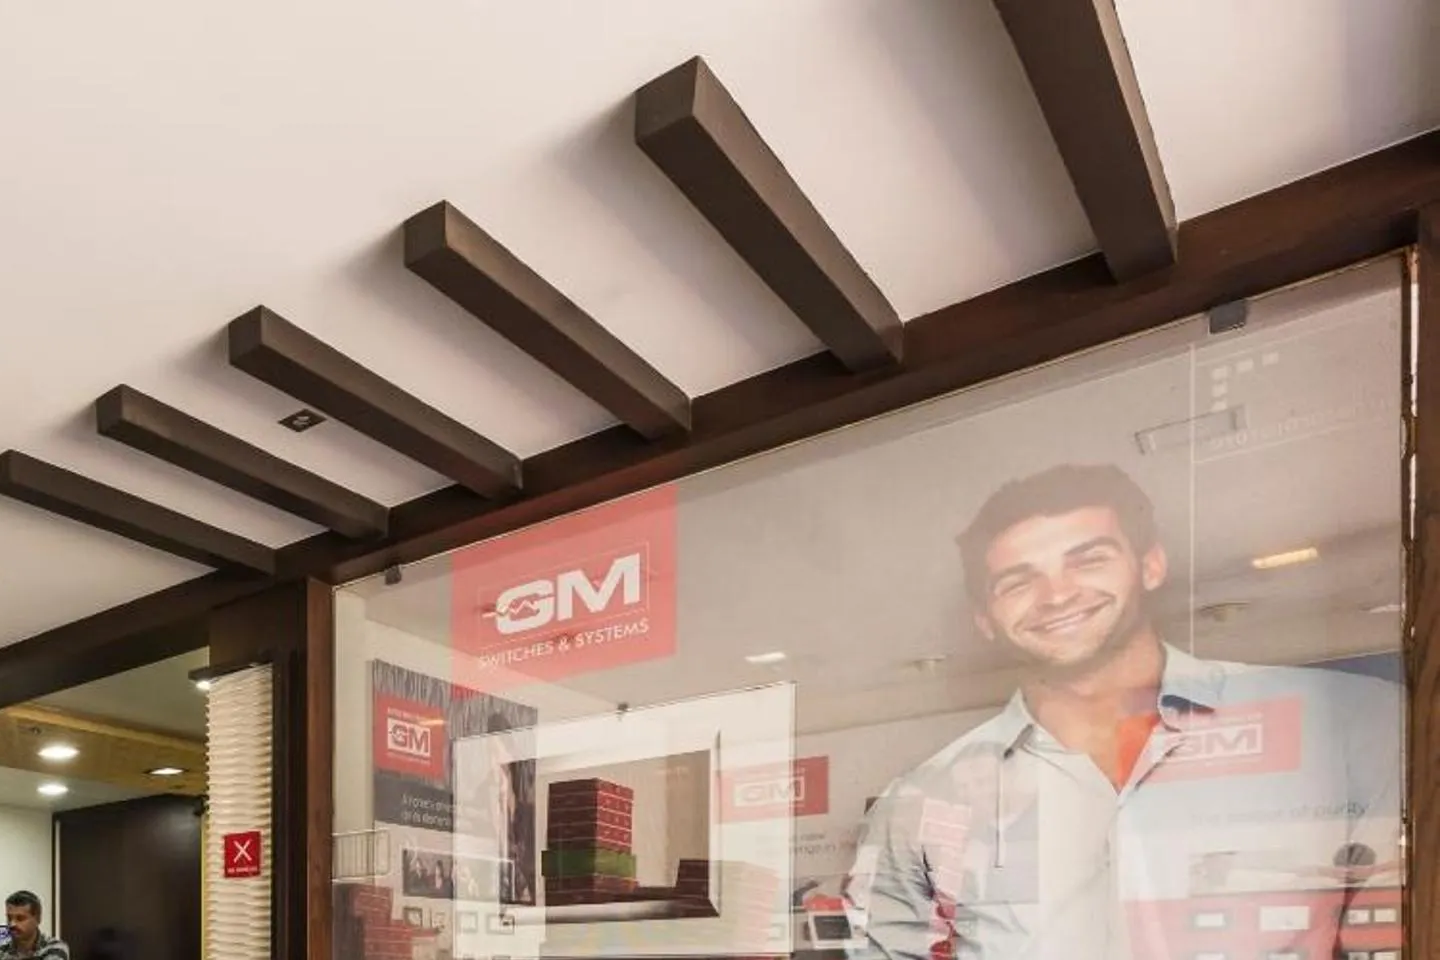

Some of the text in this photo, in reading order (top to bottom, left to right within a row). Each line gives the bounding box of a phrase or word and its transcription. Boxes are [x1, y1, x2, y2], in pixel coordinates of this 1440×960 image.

[484, 552, 641, 635] GM
[478, 618, 651, 670] SWITCHES & SYSTEMS
[390, 724, 429, 754] GM
